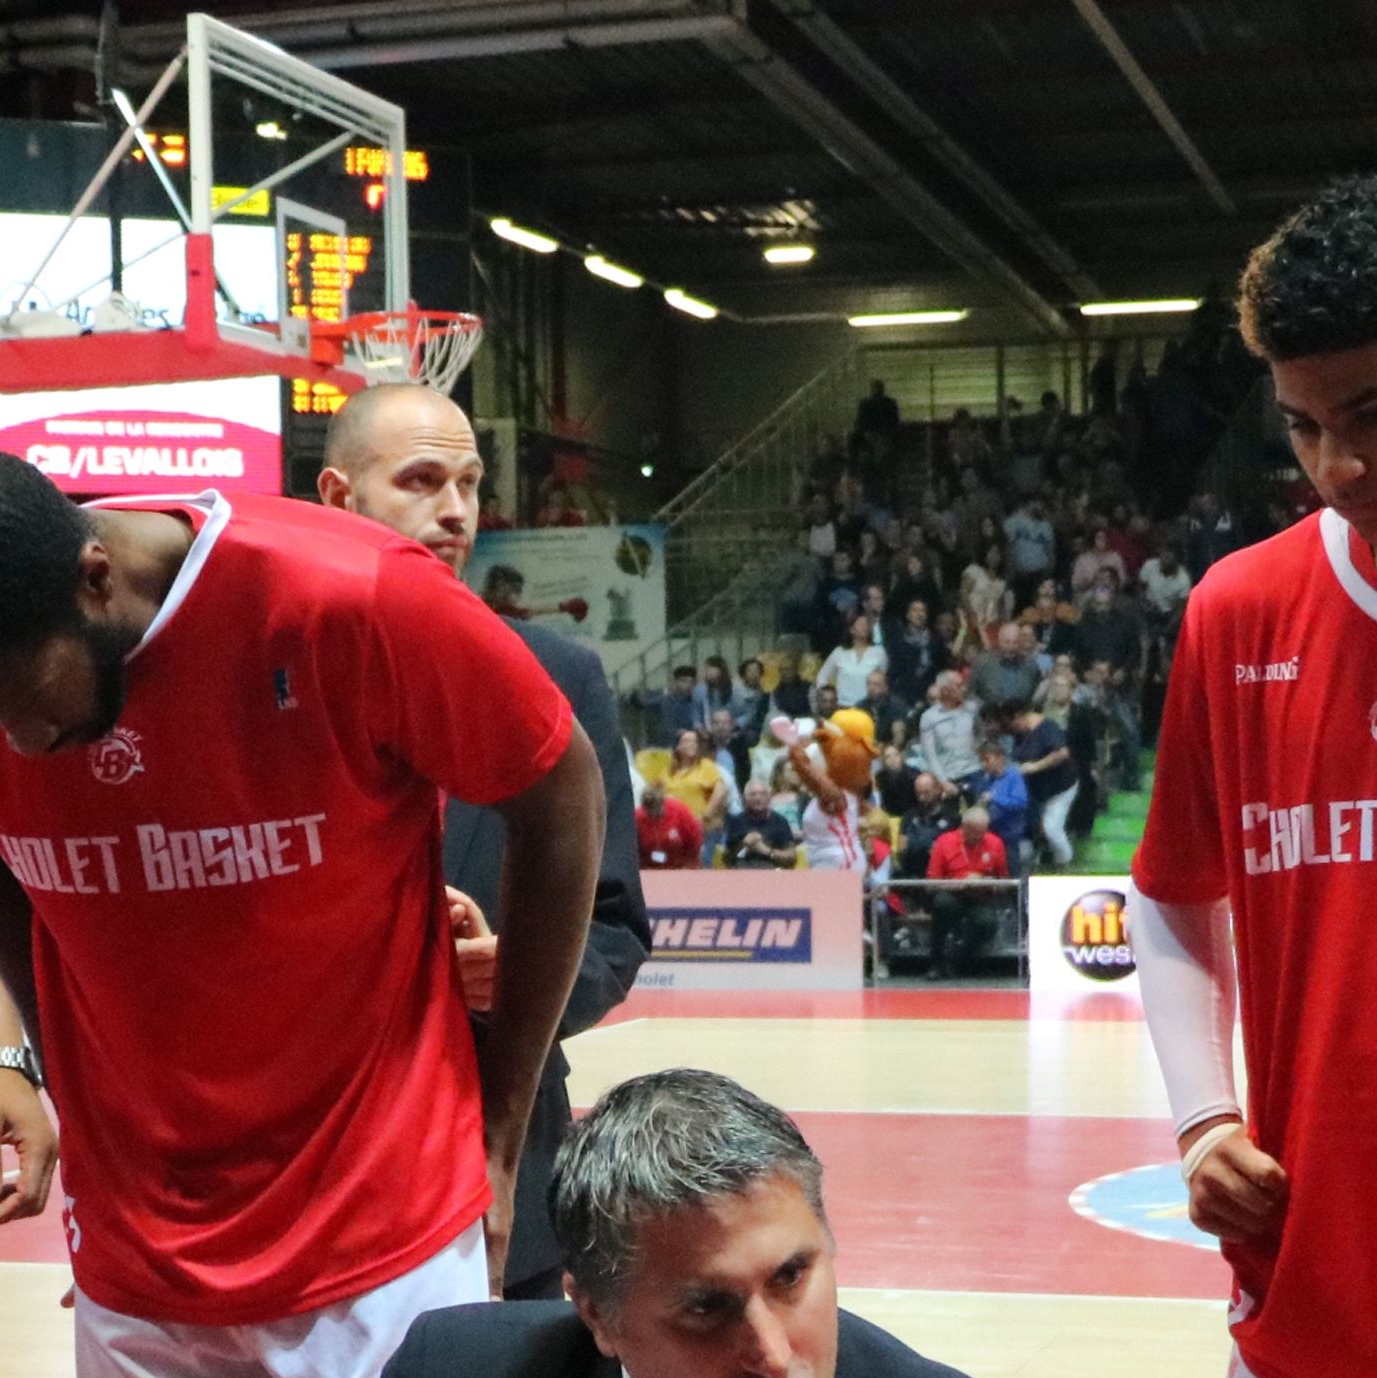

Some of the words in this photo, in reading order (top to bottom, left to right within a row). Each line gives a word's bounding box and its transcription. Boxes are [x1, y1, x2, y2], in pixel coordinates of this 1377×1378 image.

[27, 445, 244, 479] CB/LEVALLOIS
[135, 812, 326, 893] BASKET
[648, 919, 803, 947] HELIN
[1064, 945, 1137, 966] wes
